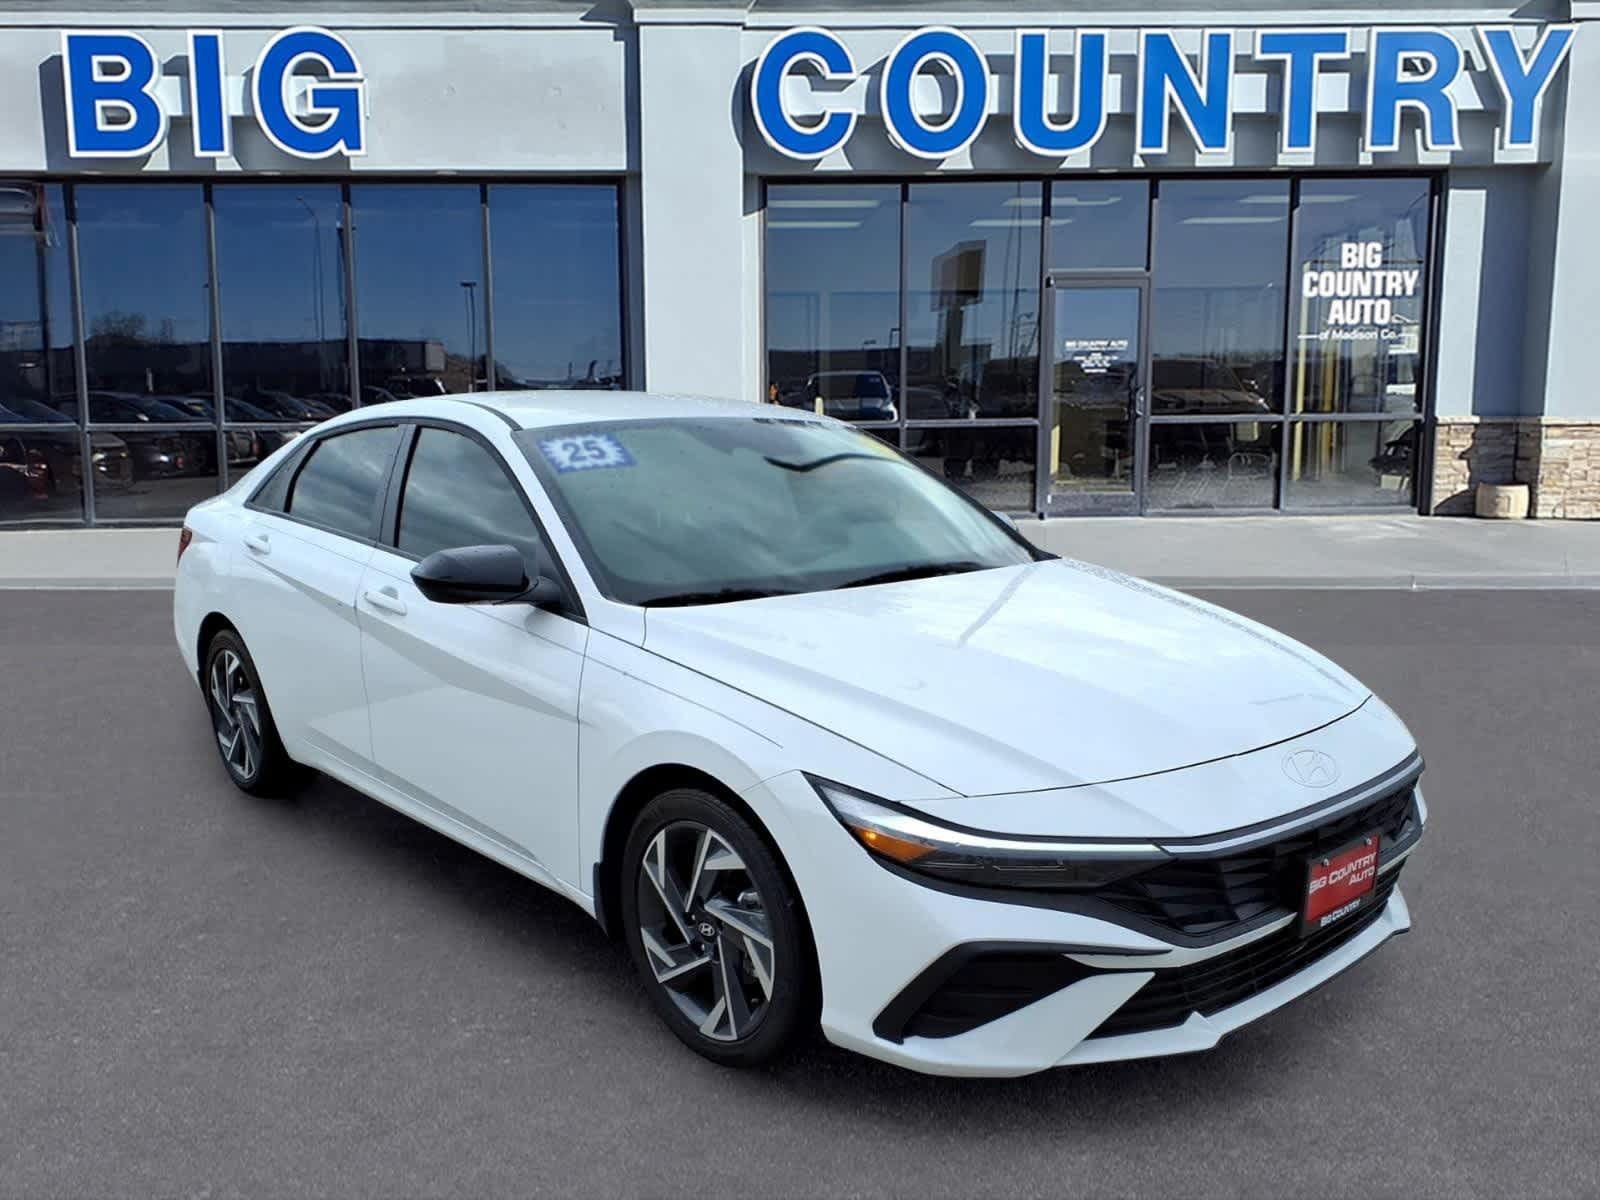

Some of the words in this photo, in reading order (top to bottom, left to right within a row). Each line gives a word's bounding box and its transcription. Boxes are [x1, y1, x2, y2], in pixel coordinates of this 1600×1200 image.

[61, 26, 366, 159] BIG
[750, 25, 1576, 160] COUNTRY
[1341, 242, 1382, 269] BIG
[1303, 270, 1419, 297] COUNTRY
[1328, 299, 1391, 325] AUTO
[1319, 330, 1331, 340] of
[1332, 330, 1378, 339] Madison
[562, 440, 606, 462] 25
[1329, 852, 1377, 885] COUNTRY
[1349, 866, 1375, 886] AUTO
